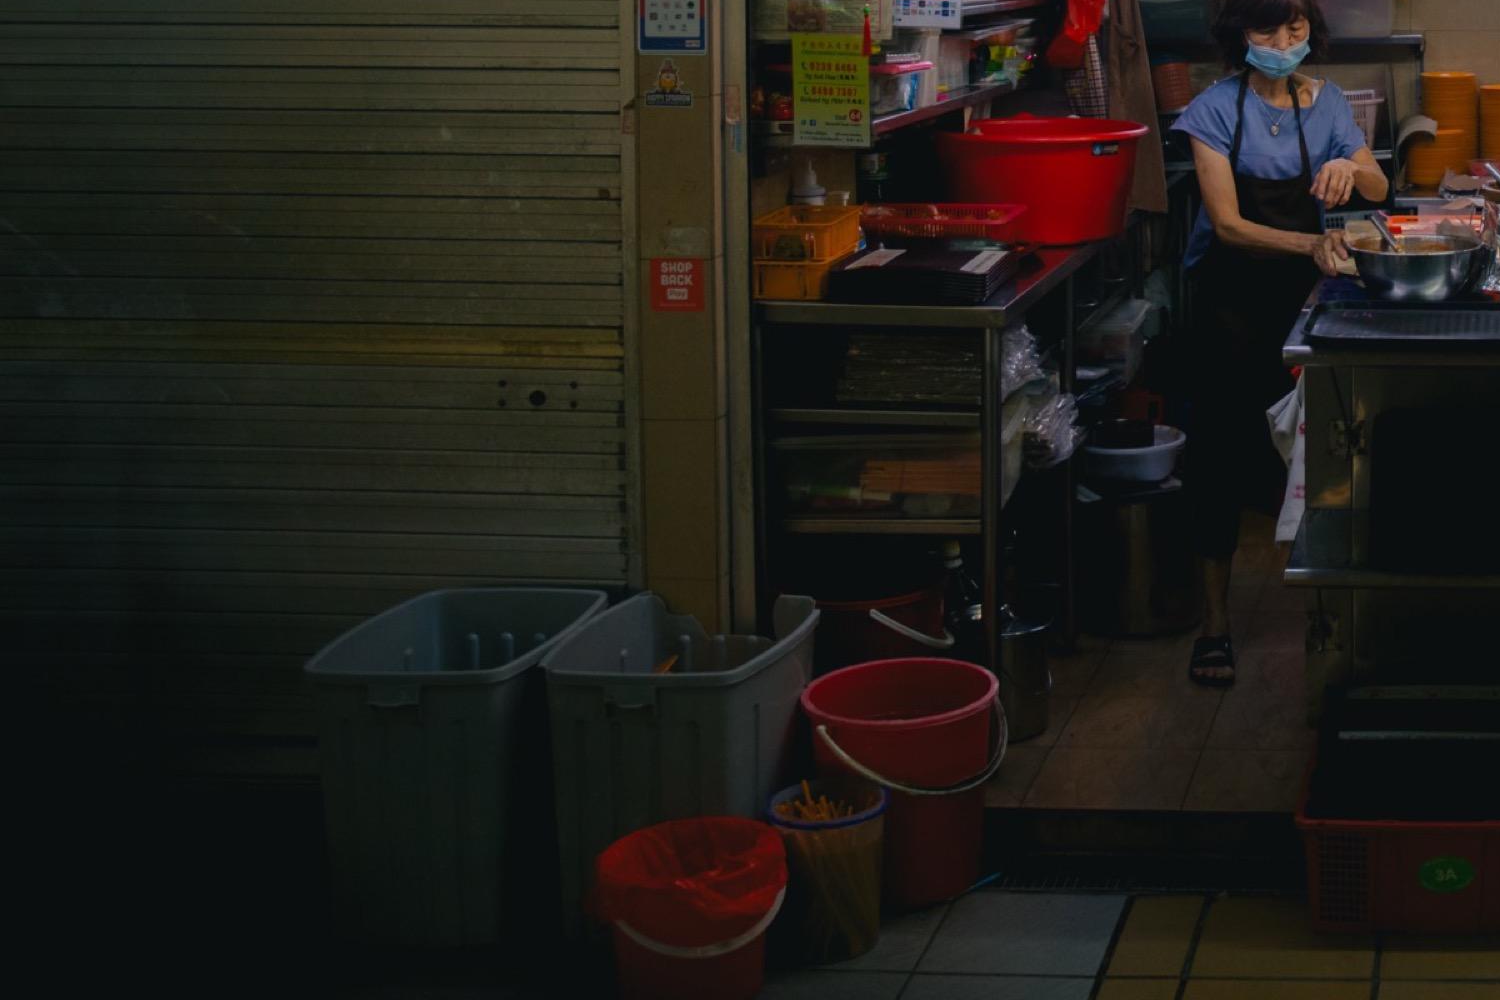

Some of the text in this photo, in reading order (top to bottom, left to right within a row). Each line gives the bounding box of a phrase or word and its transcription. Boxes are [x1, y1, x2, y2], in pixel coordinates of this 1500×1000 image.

[660, 261, 693, 273] SHOP
[660, 274, 694, 286] BACK
[1434, 867, 1457, 881] 3A
